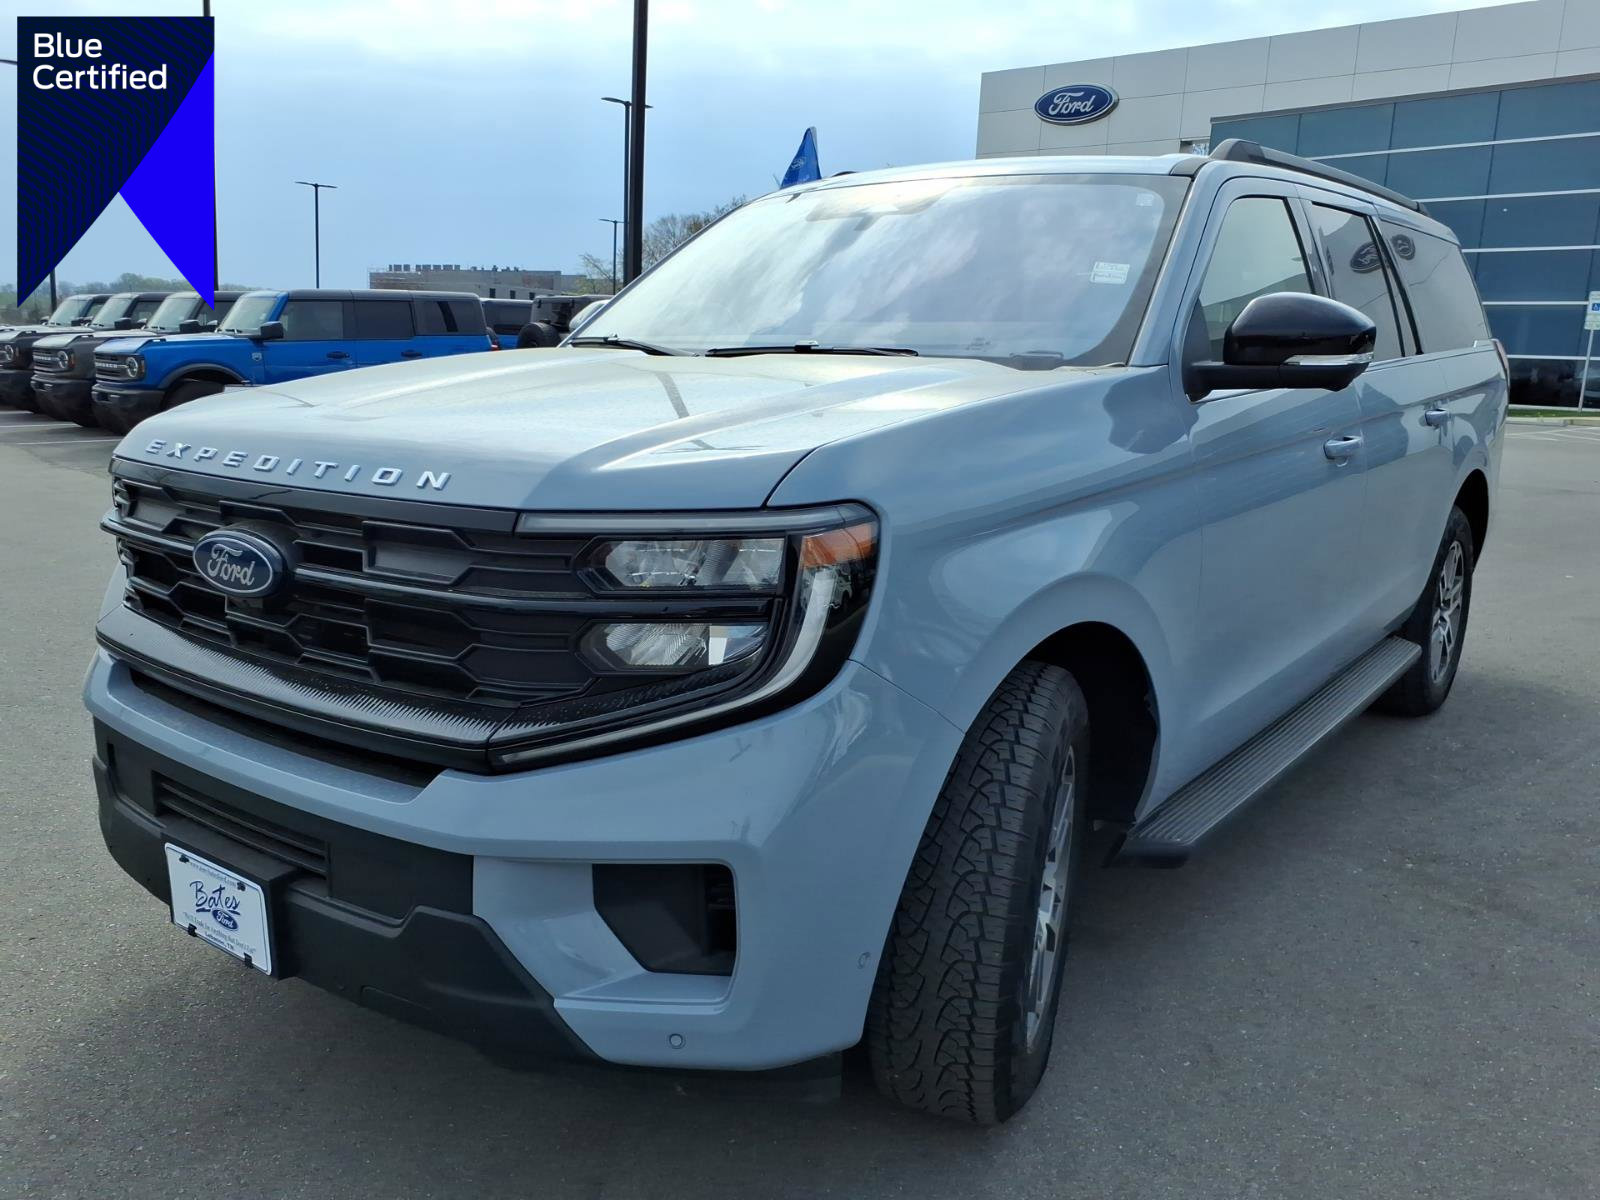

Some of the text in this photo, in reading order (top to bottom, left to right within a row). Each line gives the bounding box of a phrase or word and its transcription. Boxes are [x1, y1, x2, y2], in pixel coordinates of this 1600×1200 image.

[1048, 91, 1096, 116] Ford
[145, 439, 453, 491] EXPEDITION
[207, 543, 255, 586] Ford
[189, 880, 241, 910] Bates
